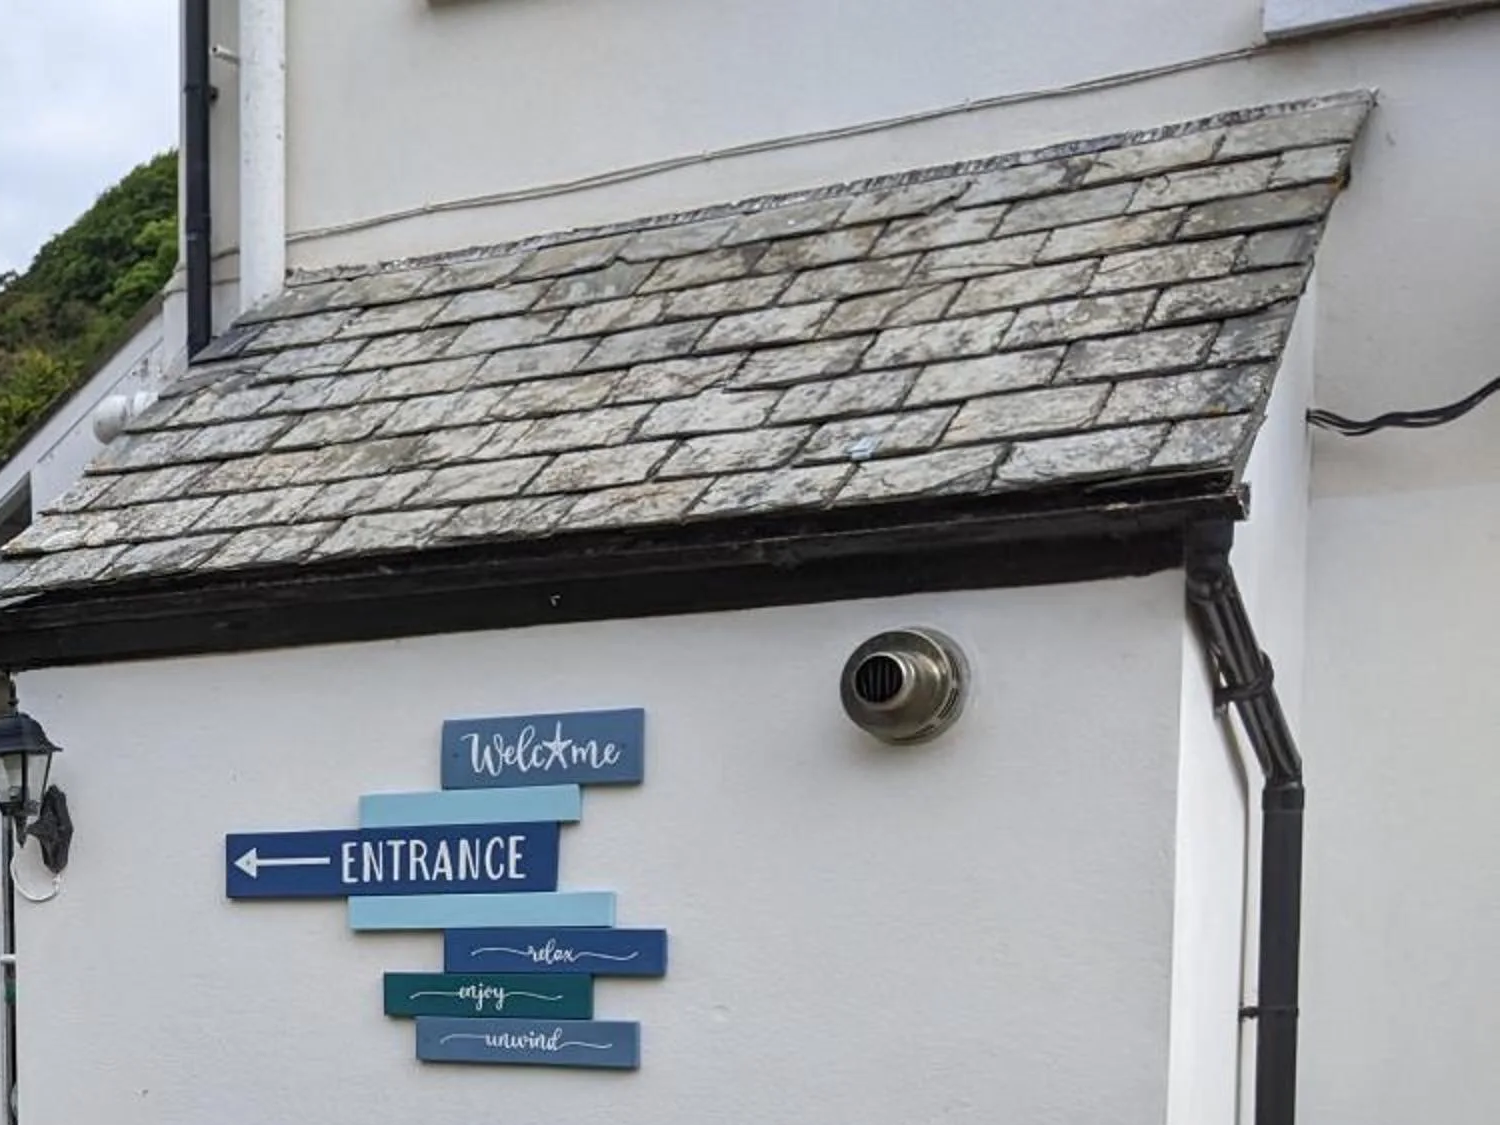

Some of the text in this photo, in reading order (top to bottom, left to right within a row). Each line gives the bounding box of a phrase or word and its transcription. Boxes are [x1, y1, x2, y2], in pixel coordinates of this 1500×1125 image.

[341, 835, 527, 884] ENTRANCE
[526, 938, 579, 964] relax
[459, 982, 508, 1011] enjoy
[485, 1027, 563, 1051] unwind
